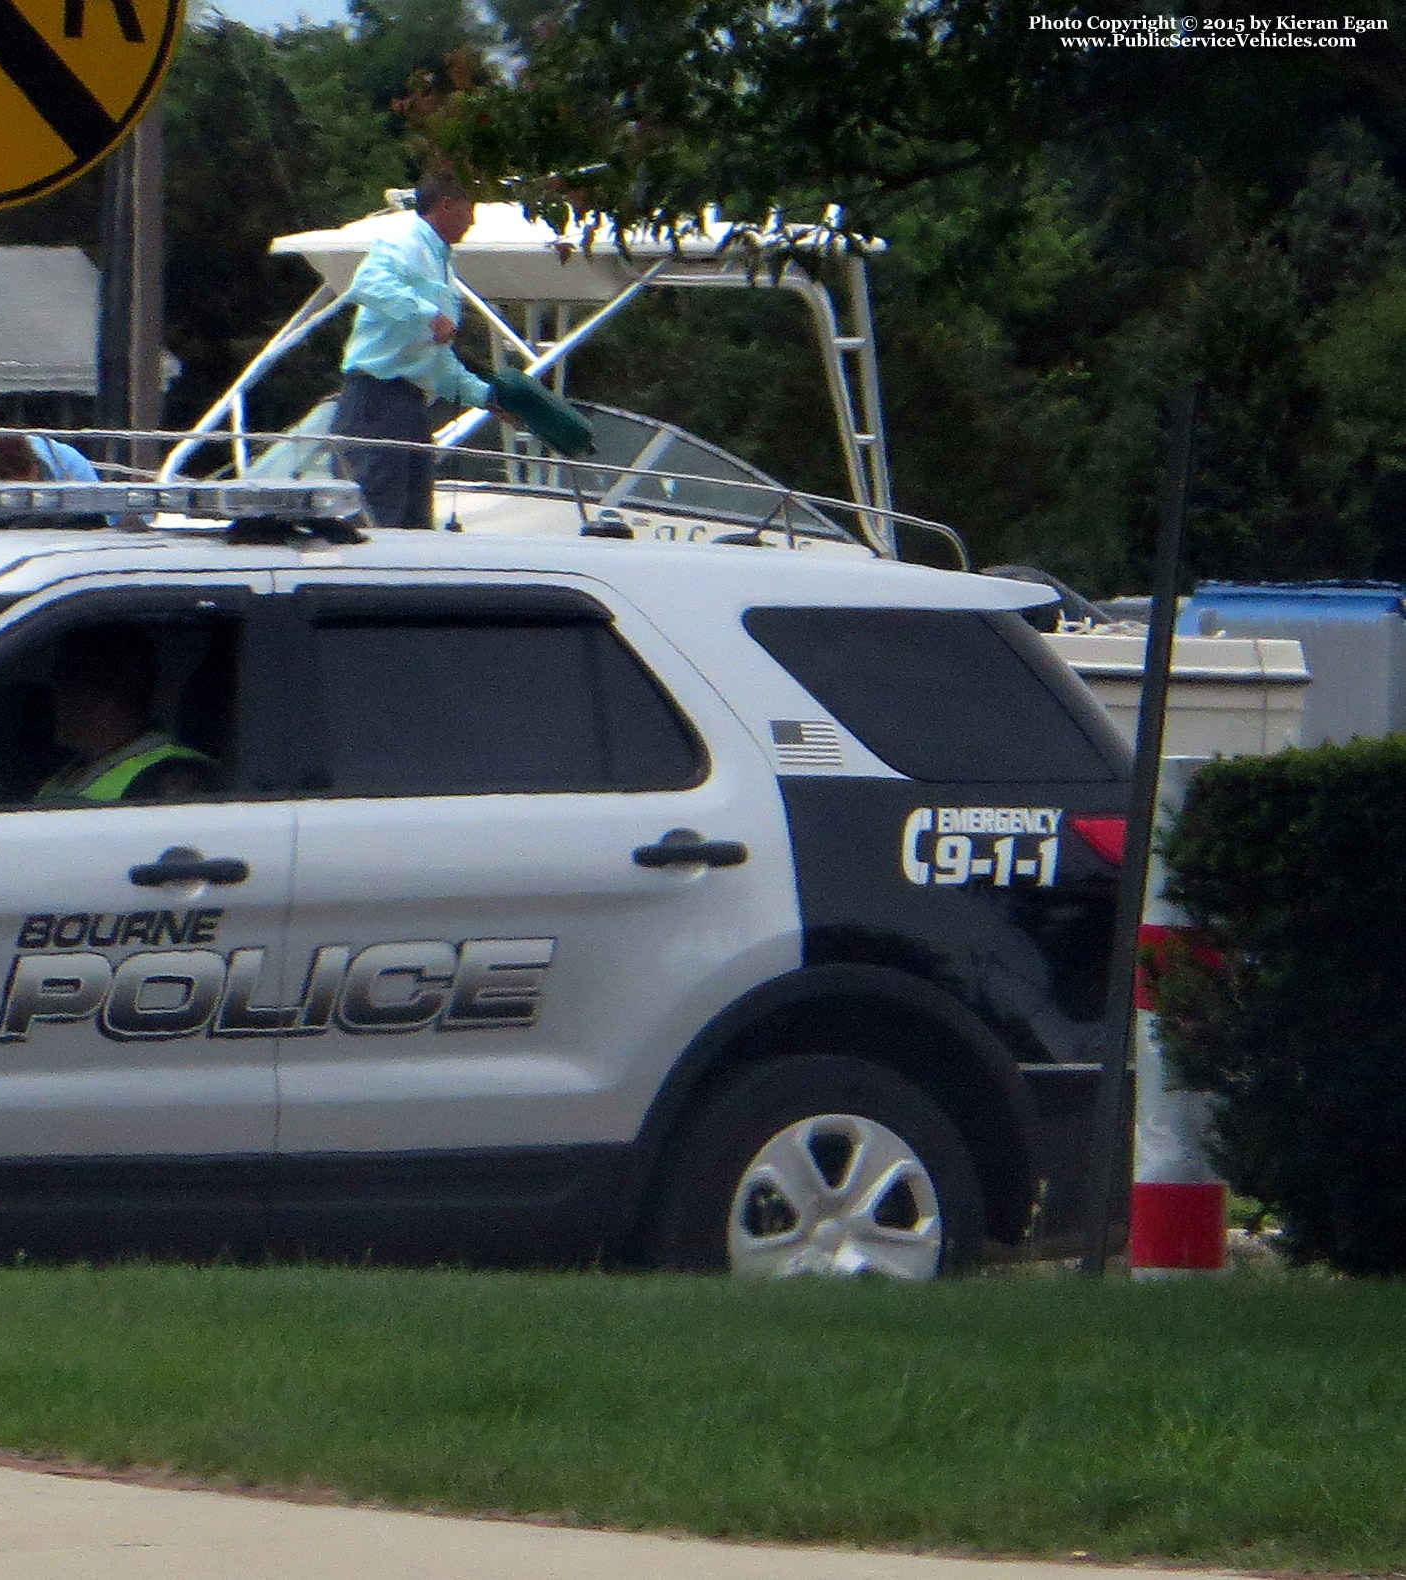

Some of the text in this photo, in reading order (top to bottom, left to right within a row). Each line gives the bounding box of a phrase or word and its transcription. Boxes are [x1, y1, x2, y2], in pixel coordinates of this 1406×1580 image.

[936, 807, 1064, 834] EMERGENCY
[933, 835, 1060, 888] 9-1-1
[17, 907, 225, 948] BOURNE
